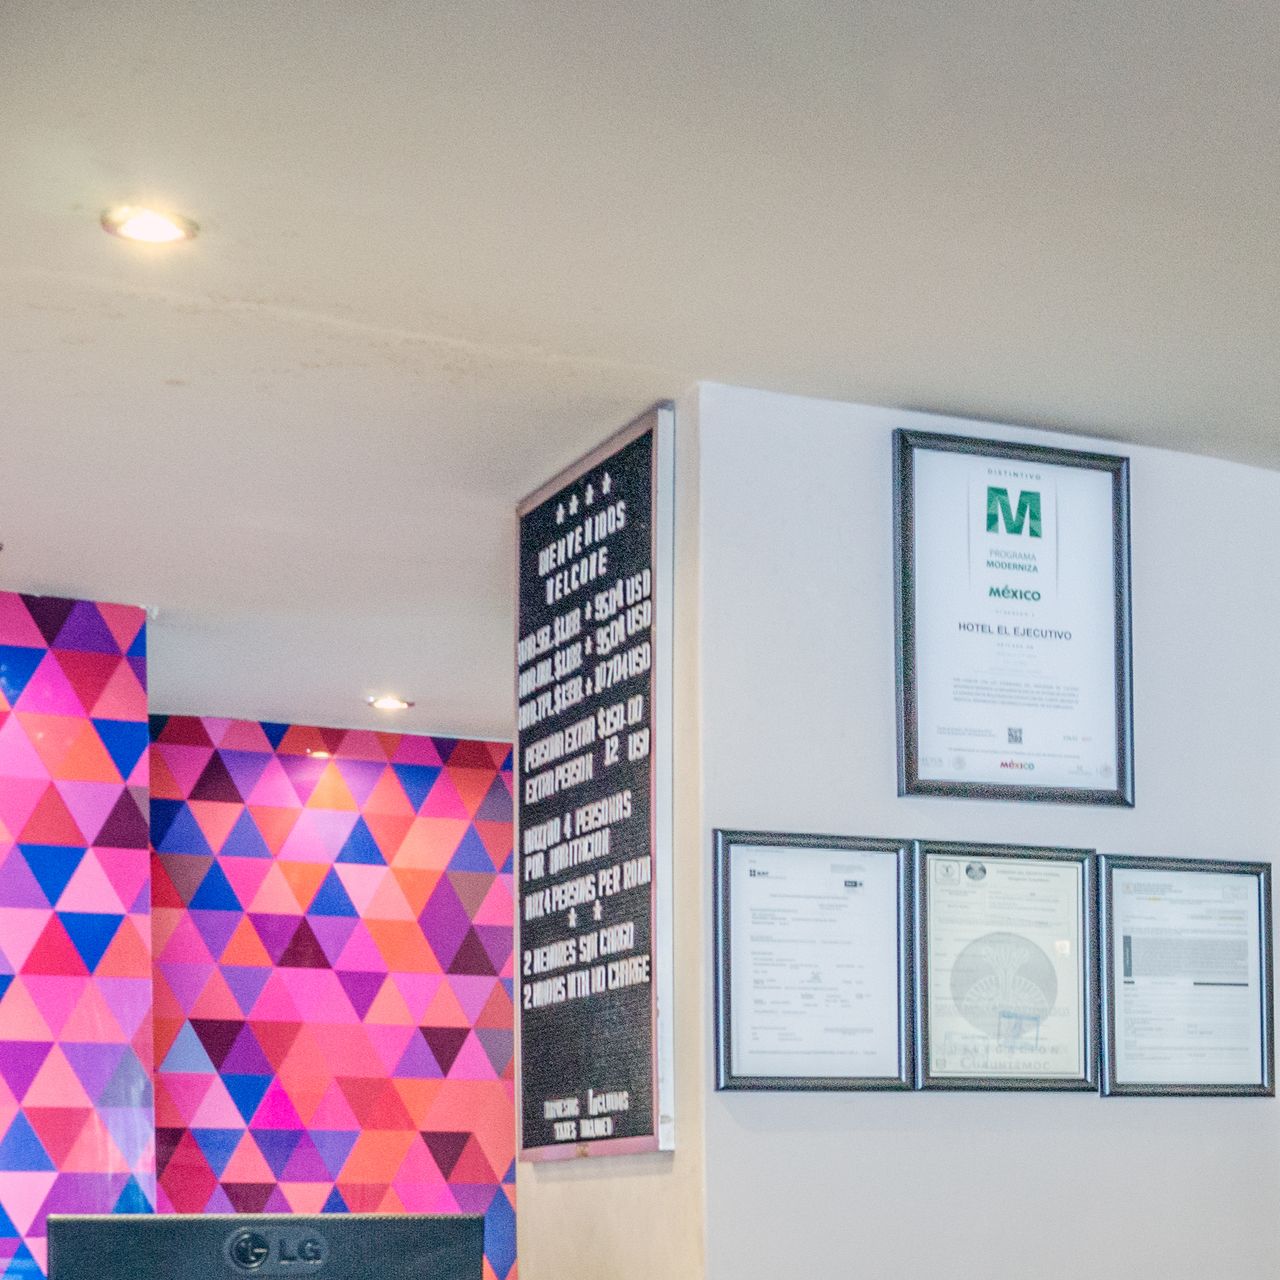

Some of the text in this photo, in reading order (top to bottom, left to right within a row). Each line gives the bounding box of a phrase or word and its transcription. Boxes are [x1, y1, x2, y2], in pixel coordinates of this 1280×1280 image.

[987, 468, 1041, 481] DISTINTIVO
[986, 486, 1042, 538] M
[539, 502, 625, 575] BIENVENIDOS
[989, 549, 1037, 561] PROGRAMA
[547, 547, 607, 604] WELCOME
[627, 570, 650, 604] USD
[986, 561, 1038, 572] MODERNIZA
[627, 601, 651, 634] USD
[958, 622, 1072, 641] HOTEL EL EJECUTIVO
[628, 643, 650, 676] USD
[525, 733, 564, 772] PERSONA
[565, 717, 595, 753] EXTRA
[526, 771, 554, 804] EXTRA
[555, 753, 593, 791] PERSON
[564, 813, 571, 838] 4
[576, 790, 631, 835] PERSONAS
[525, 828, 610, 880] POR HABITACION
[543, 888, 551, 914] 4
[552, 875, 595, 911] PERSONS
[599, 865, 620, 896] PER
[624, 856, 651, 889] ROOM
[524, 951, 531, 975] 2
[580, 932, 597, 962] SIN
[600, 922, 634, 955] CARGO
[524, 985, 531, 1009] 2
[592, 966, 605, 993] NO
[608, 955, 649, 989] CHARGE
[279, 1239, 322, 1262] LG
